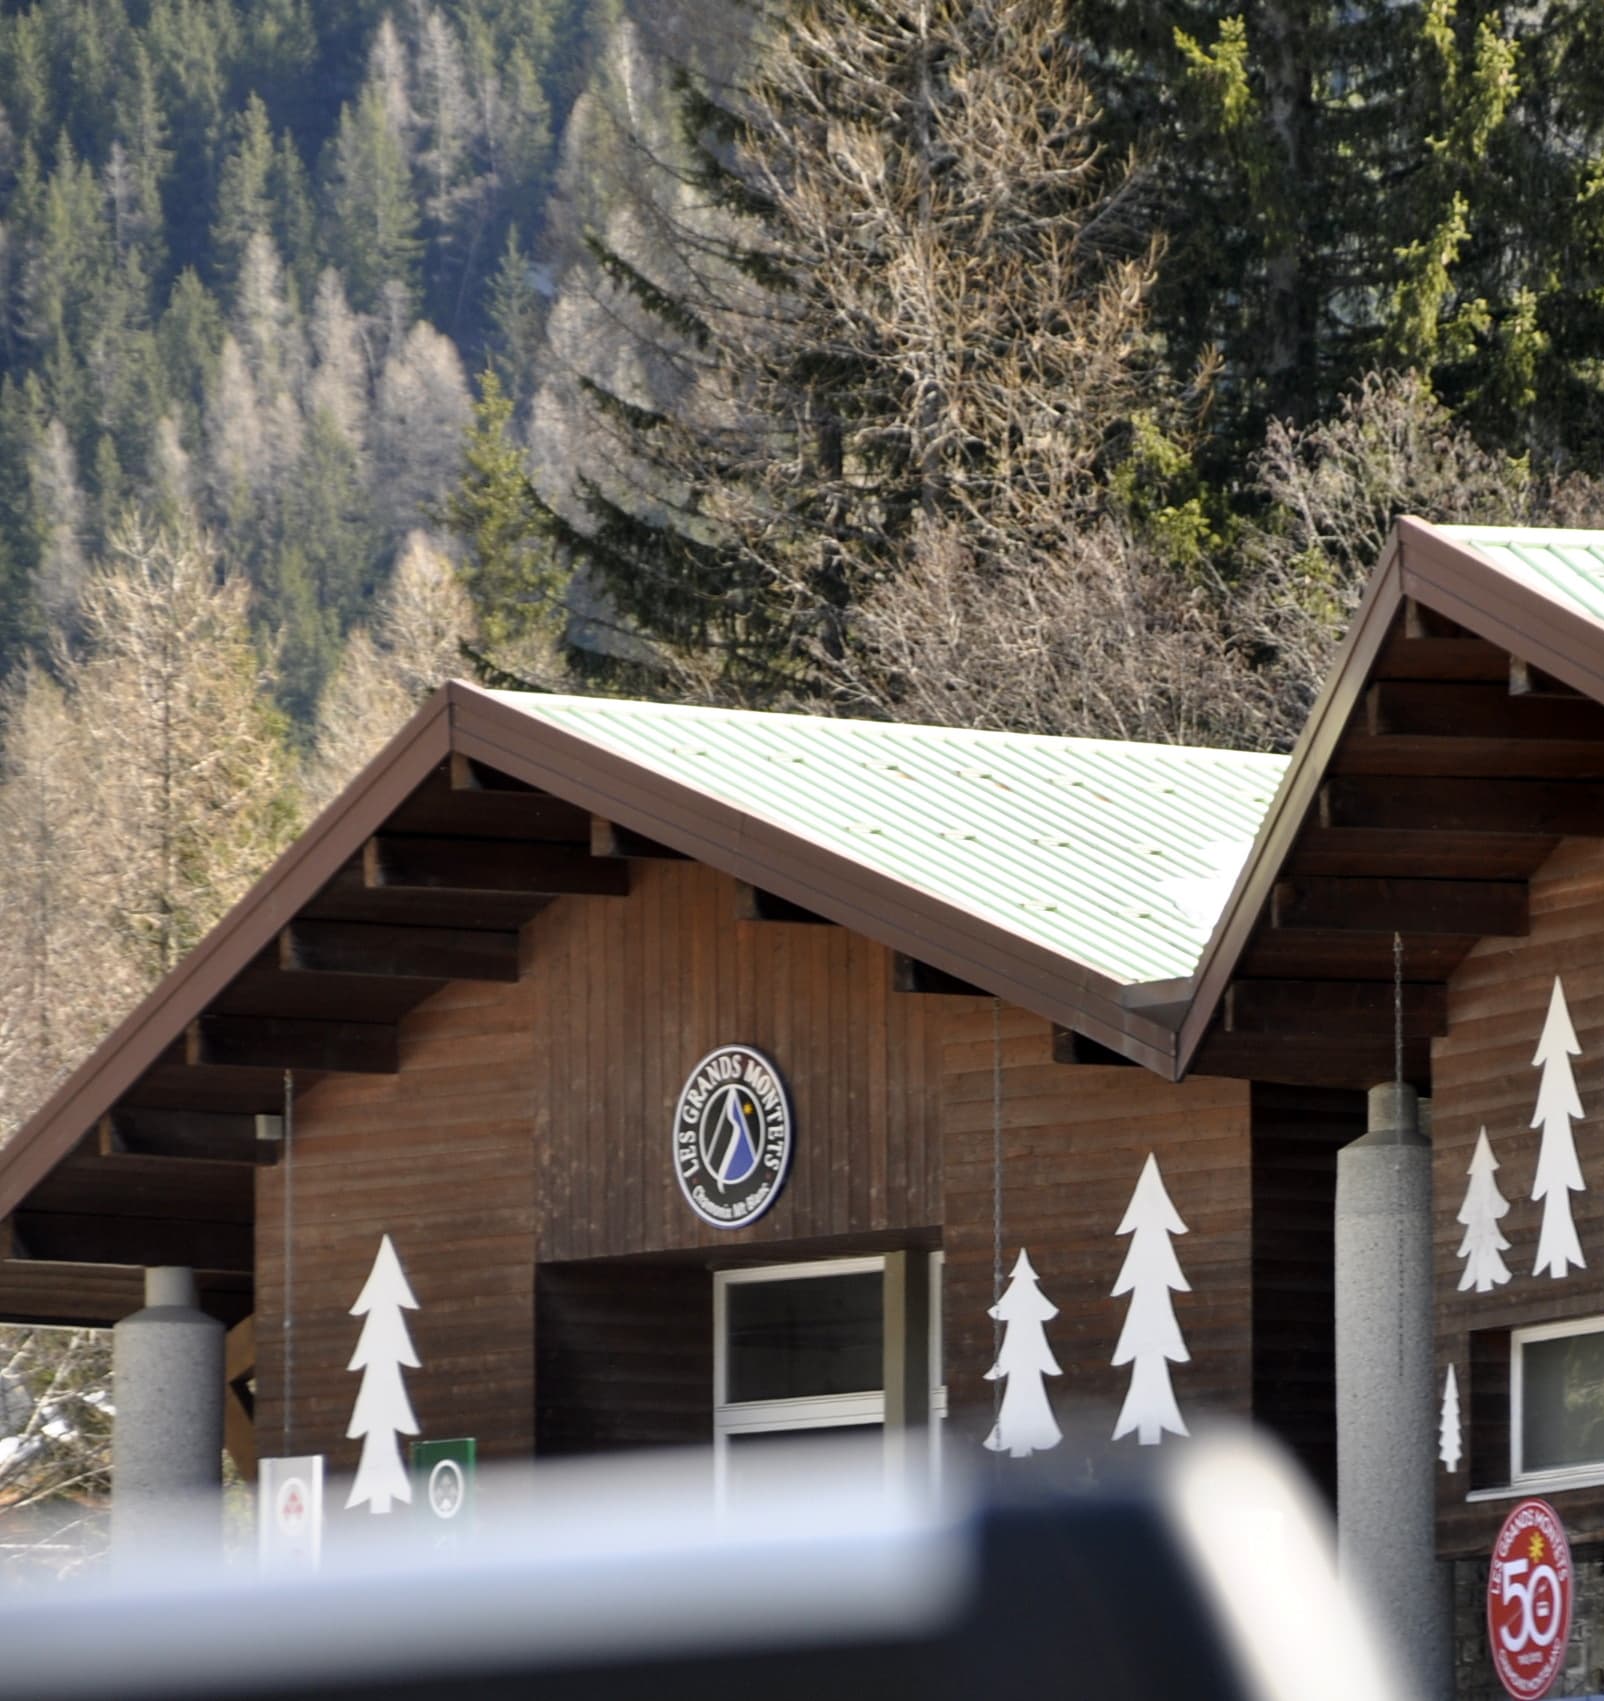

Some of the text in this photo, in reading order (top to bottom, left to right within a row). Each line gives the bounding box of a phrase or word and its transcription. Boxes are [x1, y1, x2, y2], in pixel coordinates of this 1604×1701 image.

[679, 1054, 784, 1178] LES GRANDS MONTETS
[1500, 1556, 1563, 1652] 50
